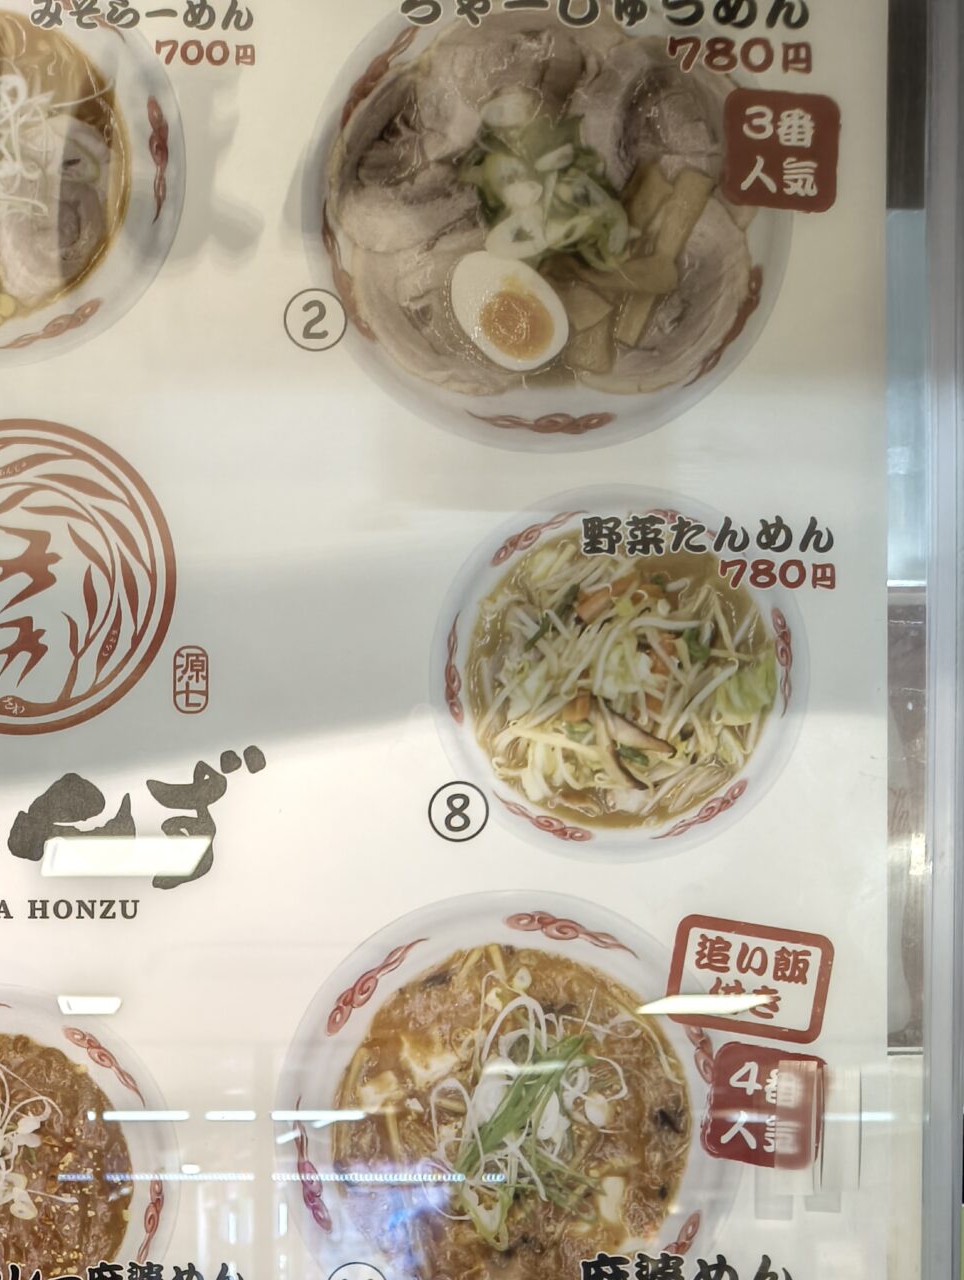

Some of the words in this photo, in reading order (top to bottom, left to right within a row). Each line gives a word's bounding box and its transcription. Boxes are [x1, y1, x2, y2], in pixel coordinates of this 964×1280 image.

[155, 39, 256, 66] 700円
[668, 36, 813, 74] 780円
[742, 104, 815, 149] 3番
[740, 156, 818, 197] 人気
[581, 515, 836, 555] 野菜たんめん
[718, 559, 837, 590] 780円
[27, 899, 141, 919] HONZU
[694, 933, 811, 985] 追い飯
